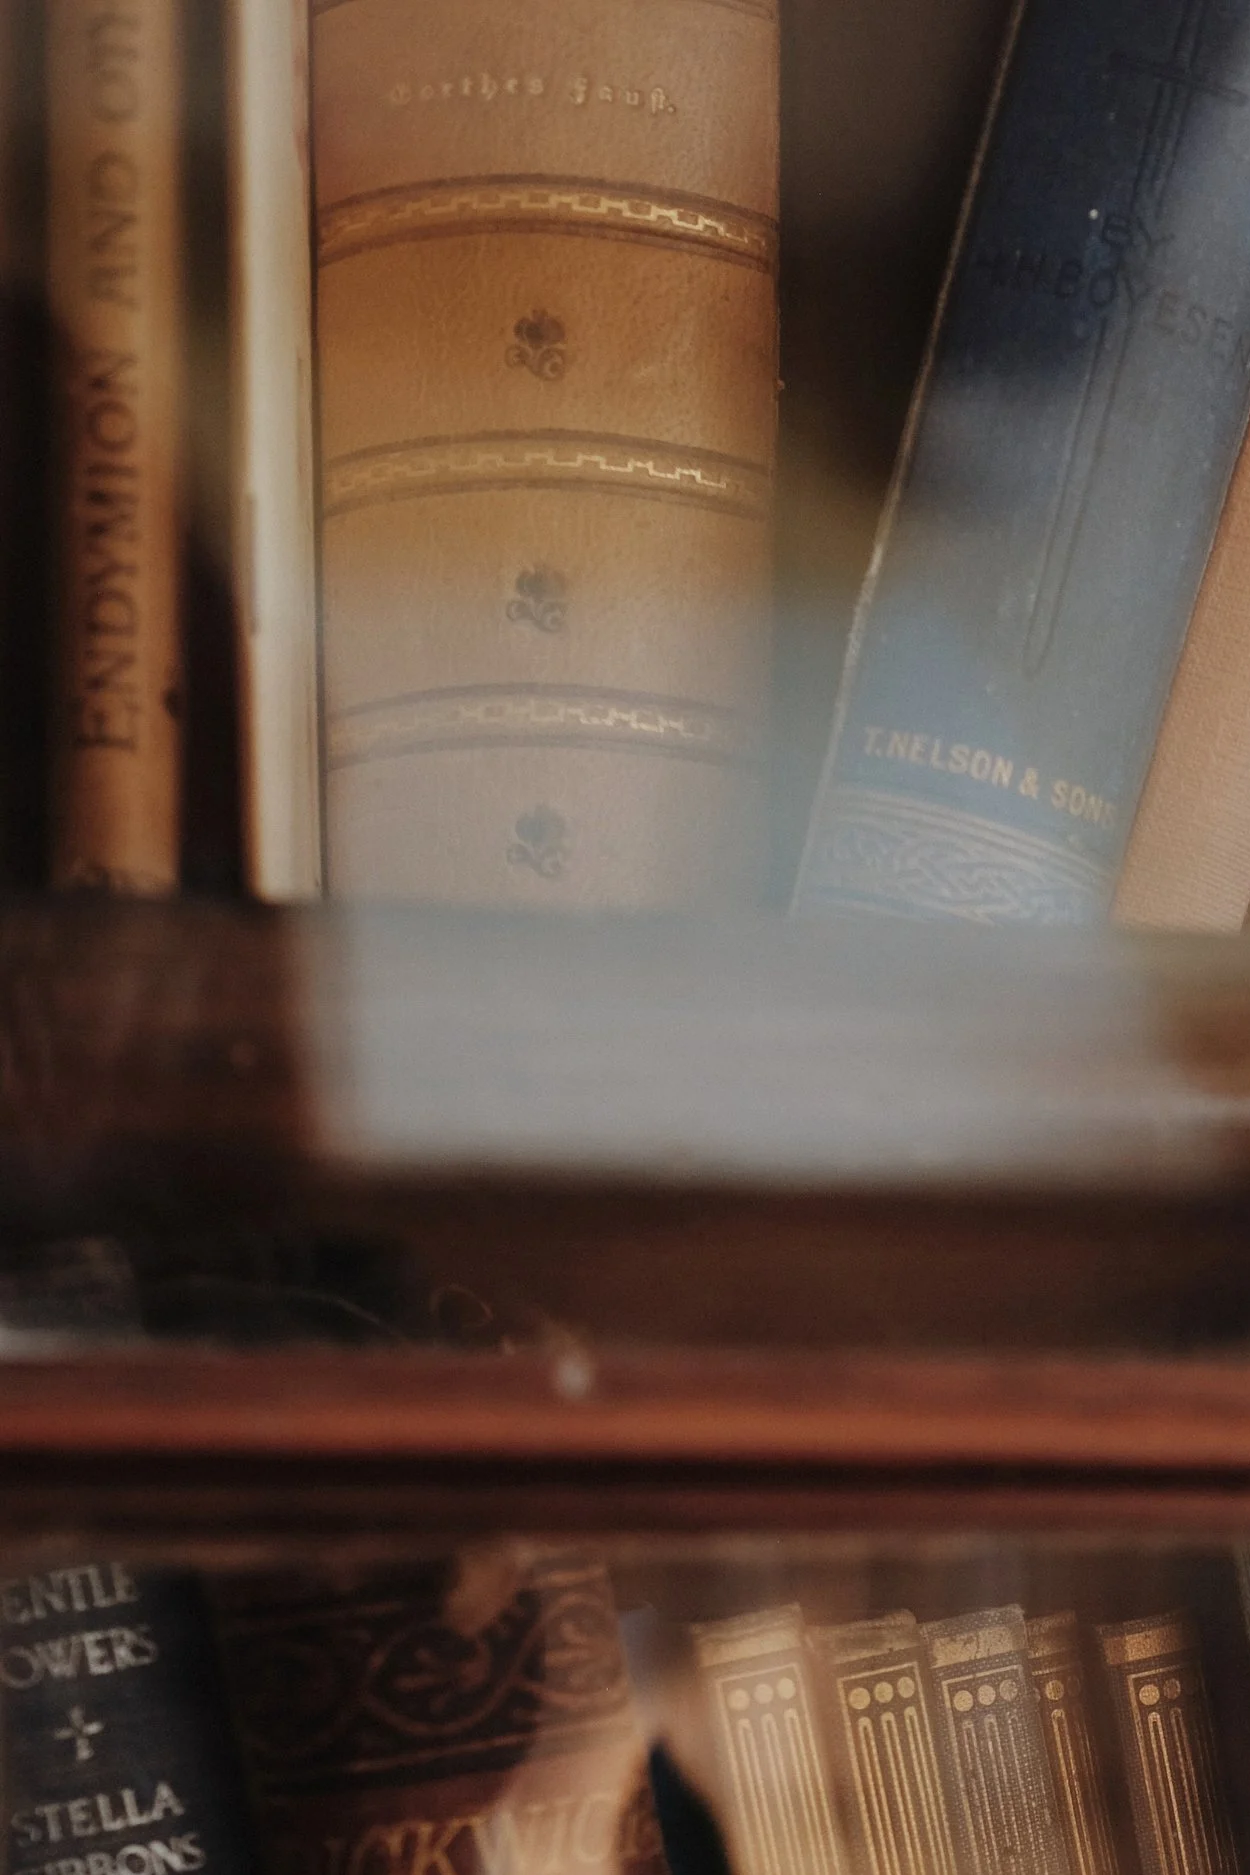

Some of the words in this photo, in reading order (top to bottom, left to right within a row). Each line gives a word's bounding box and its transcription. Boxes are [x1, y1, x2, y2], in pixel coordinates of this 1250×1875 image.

[72, 348, 138, 754] ENDYMION
[1018, 767, 1042, 800] &
[10, 1780, 187, 1848] STELLA
